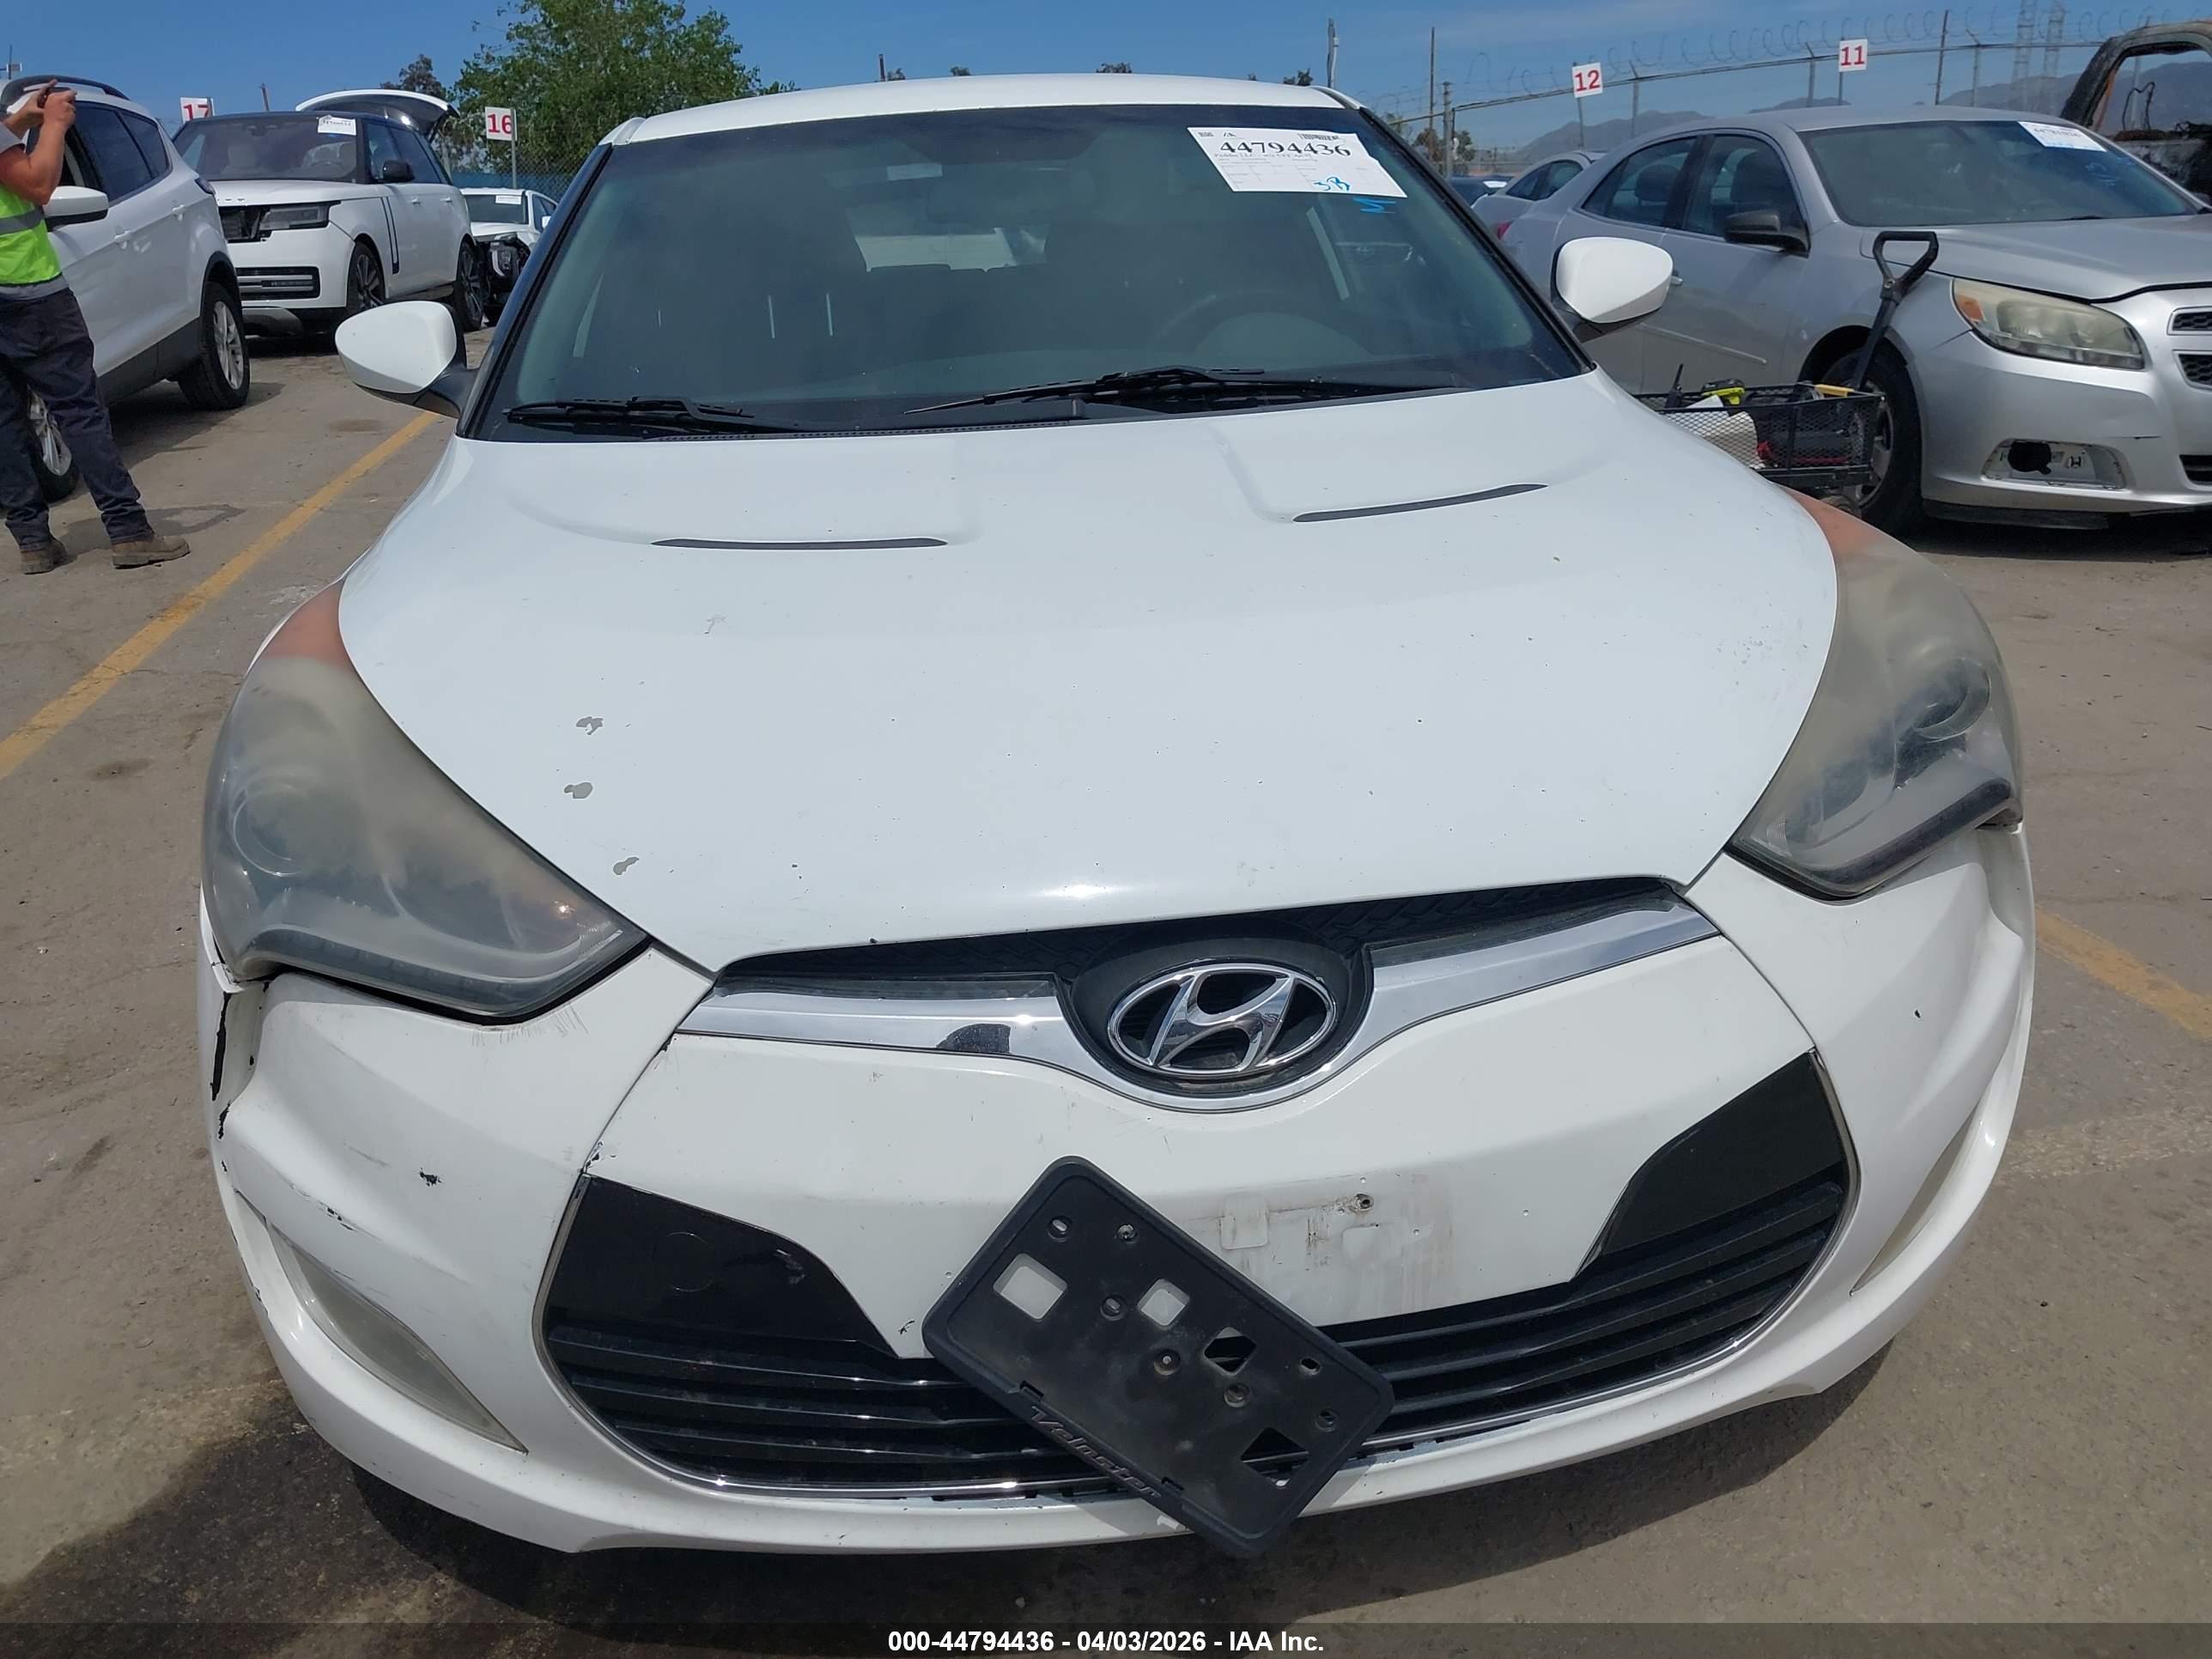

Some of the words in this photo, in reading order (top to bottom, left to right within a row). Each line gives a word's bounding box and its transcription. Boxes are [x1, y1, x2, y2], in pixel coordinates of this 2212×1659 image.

[1839, 46, 1866, 66] 11
[1573, 70, 1601, 92] 12
[183, 104, 210, 121] 17
[487, 113, 513, 135] 16
[1219, 142, 1352, 156] 44794436
